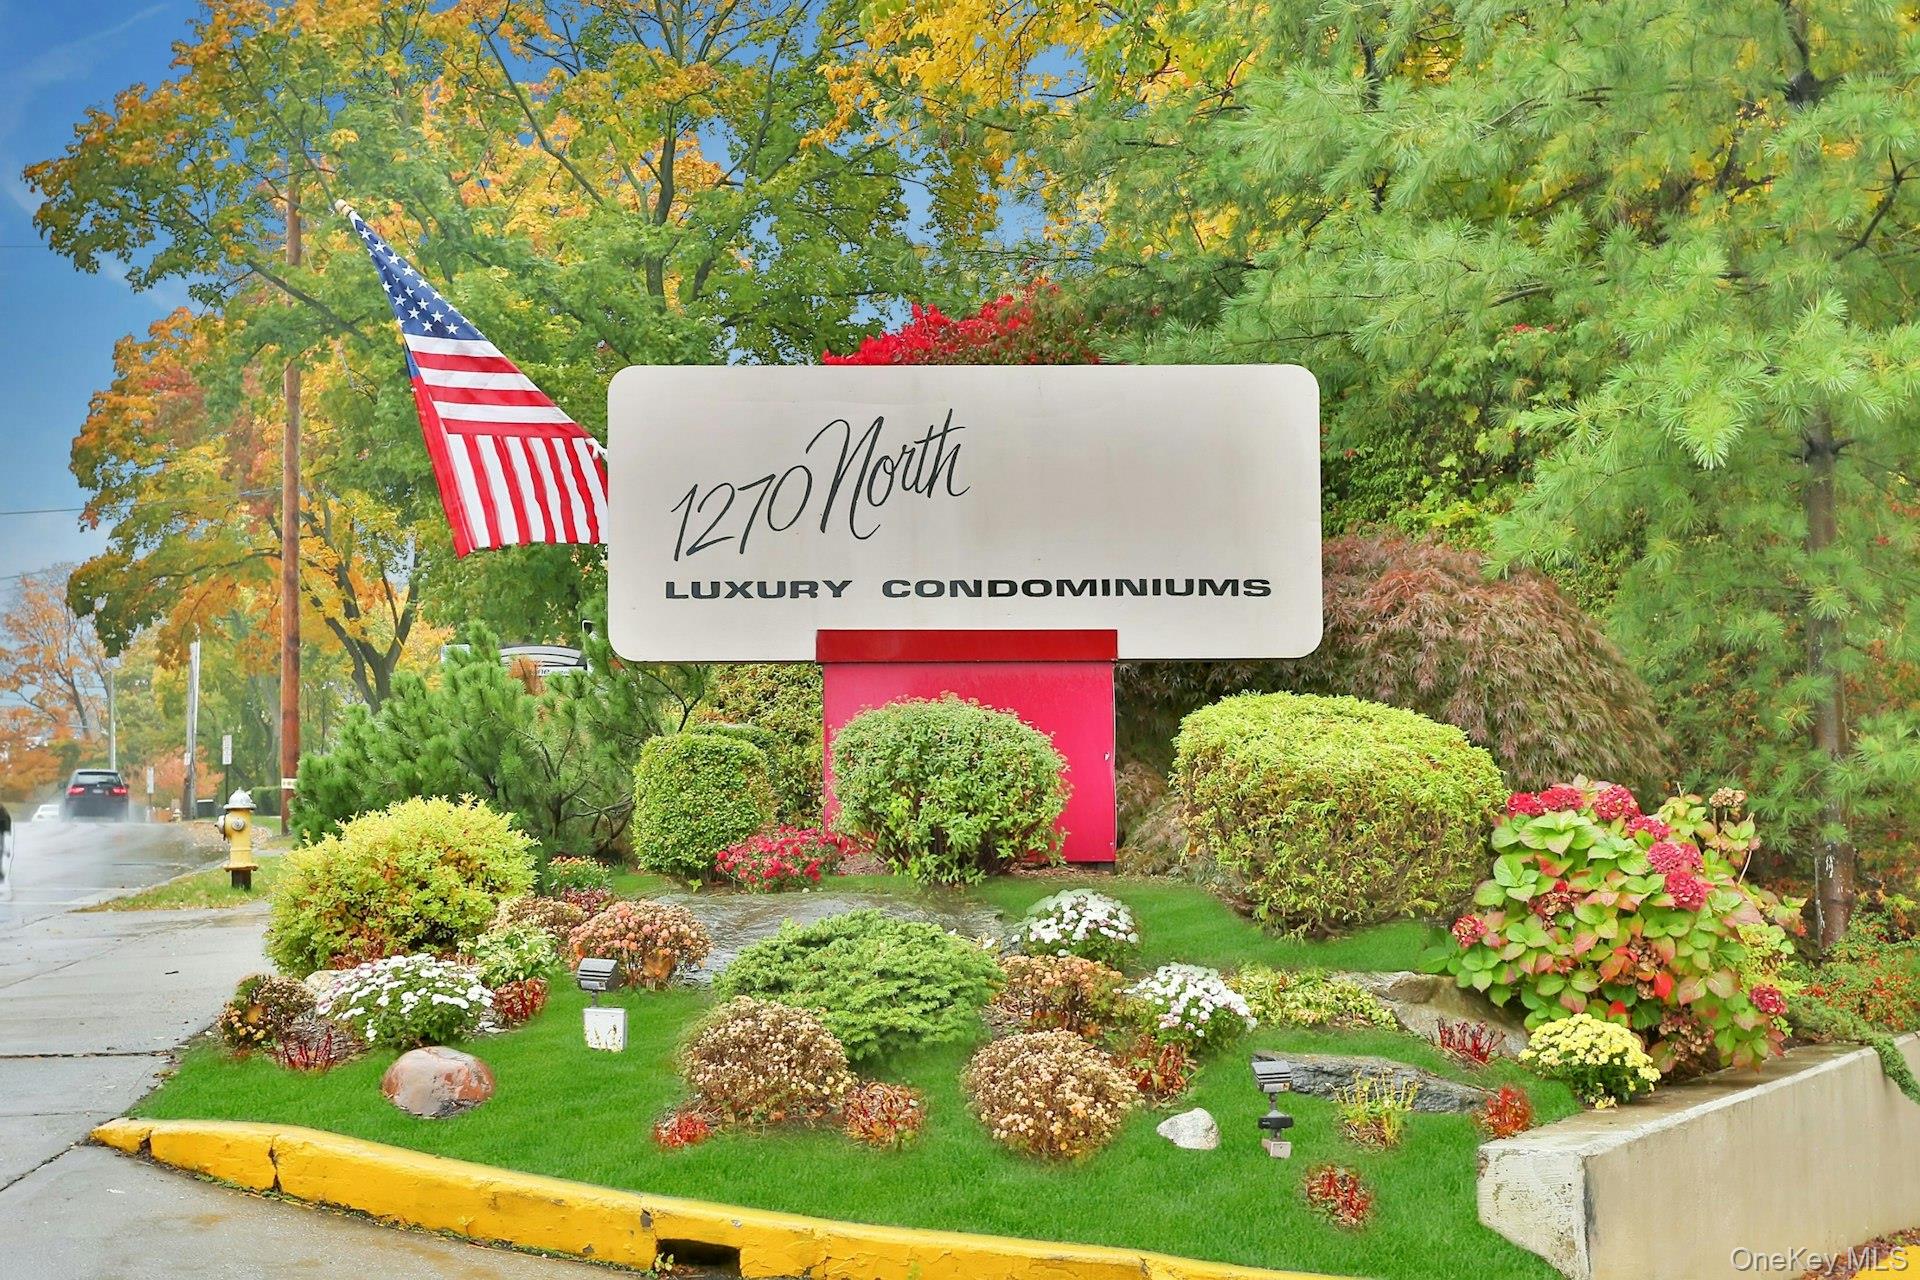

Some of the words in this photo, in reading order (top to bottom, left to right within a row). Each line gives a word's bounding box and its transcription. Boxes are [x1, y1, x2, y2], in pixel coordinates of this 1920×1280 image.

[670, 465, 812, 562] 1270
[806, 408, 971, 541] North
[665, 580, 853, 600] LUXURY
[882, 578, 1272, 599] CONDOMINIUMS
